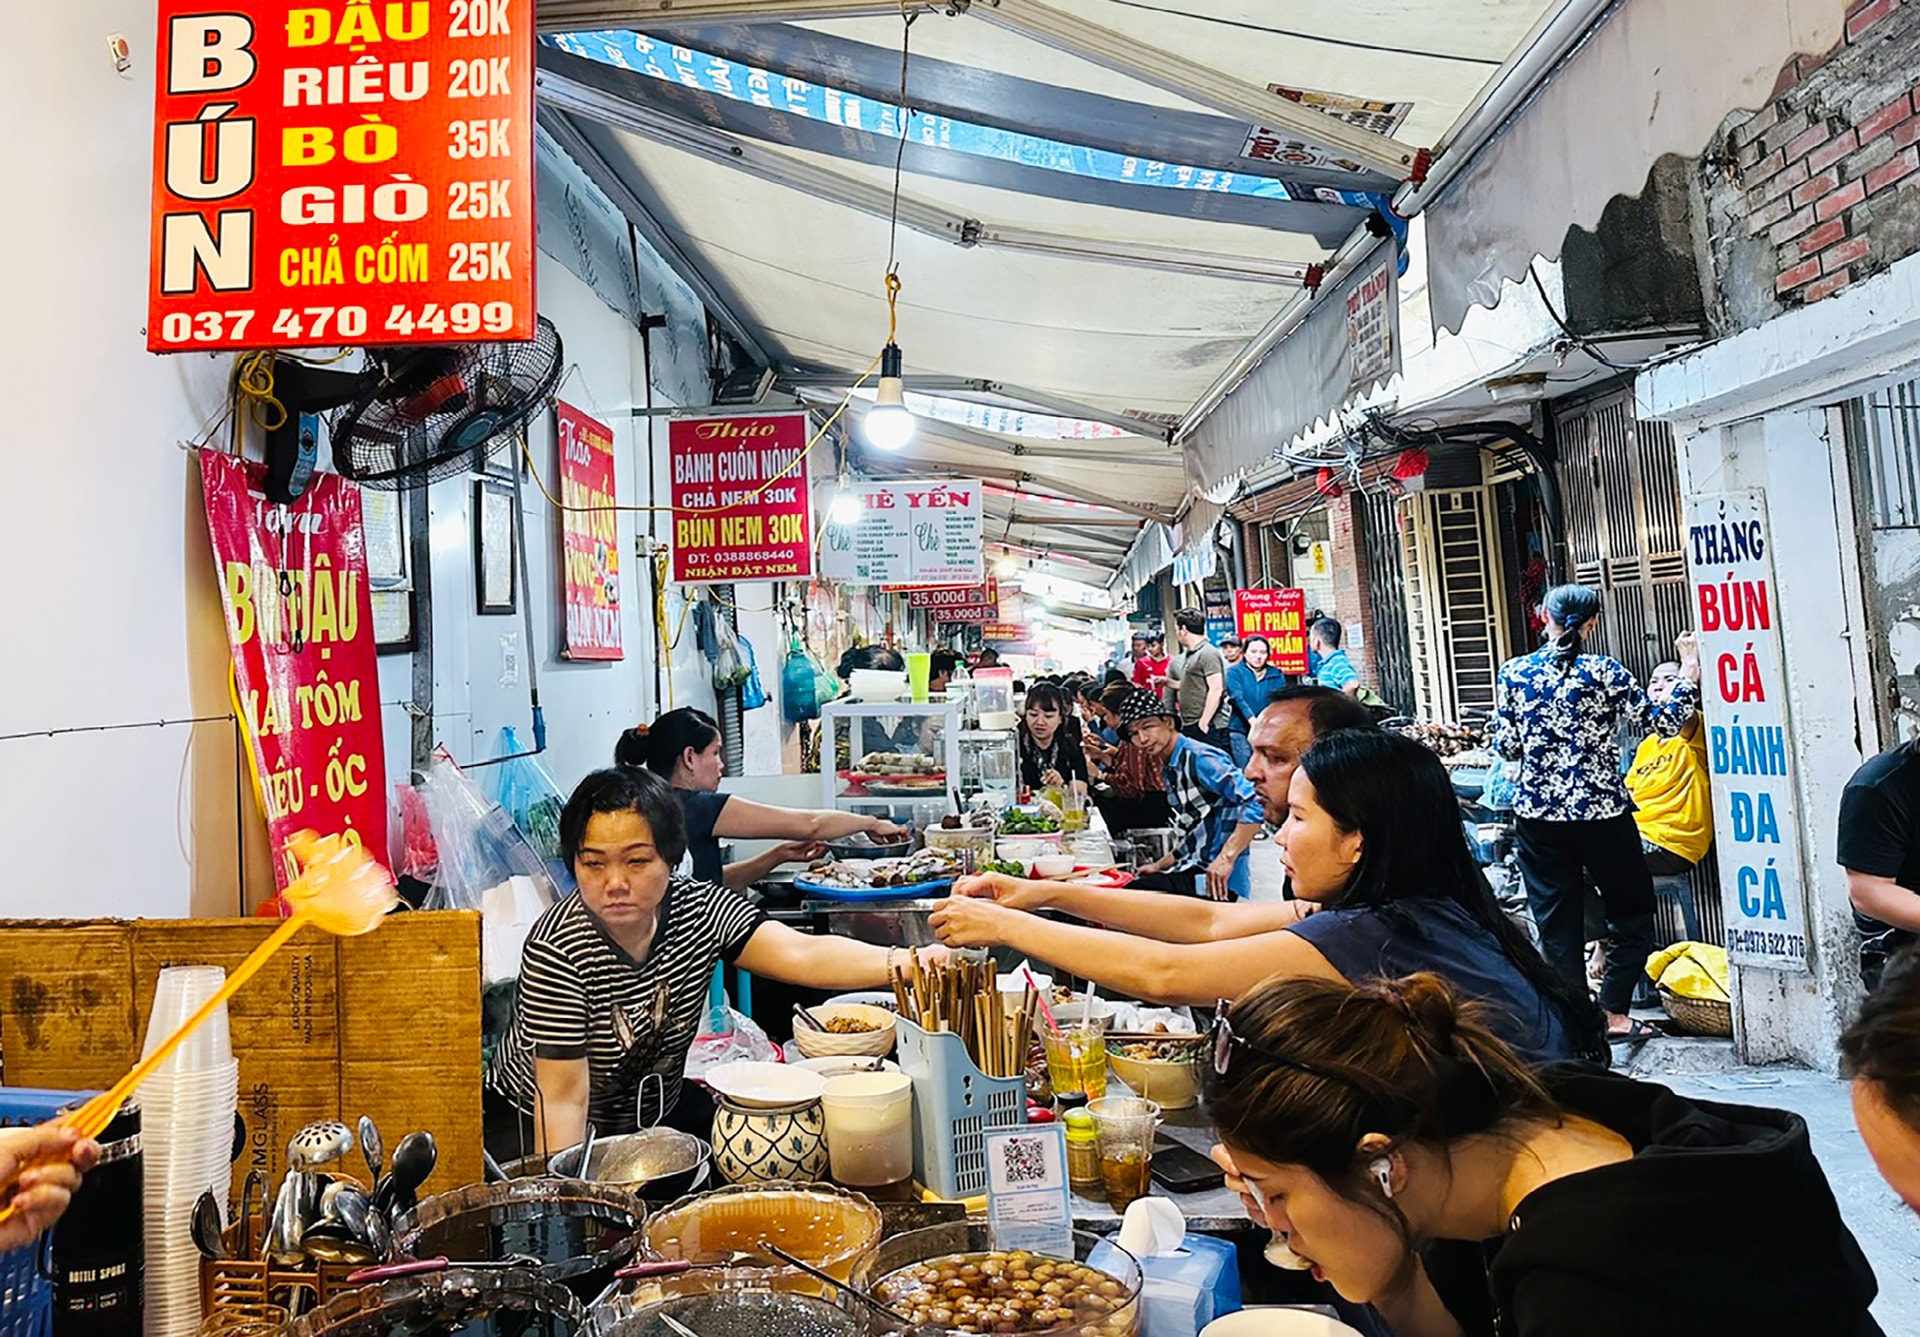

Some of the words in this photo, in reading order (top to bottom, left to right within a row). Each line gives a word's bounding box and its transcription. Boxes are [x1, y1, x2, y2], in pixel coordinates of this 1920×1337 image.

[285, 0, 430, 52] ĐẬU
[448, 0, 511, 39] 20K
[283, 56, 429, 107] RIÊU
[447, 58, 511, 98] 20K
[160, 12, 257, 297] BÚN
[281, 114, 398, 167] BÒ
[447, 120, 511, 160] 35K
[280, 174, 428, 226] GIÒ
[447, 180, 512, 221] 25K
[279, 234, 344, 287] CHẢ
[355, 232, 428, 285] CỐM
[447, 242, 512, 282] 25K
[162, 311, 256, 343] 037
[272, 306, 367, 339] 470
[384, 302, 513, 336] 4499
[674, 447, 714, 485] BÁNH
[718, 441, 757, 482] CUỐN
[761, 442, 802, 479] NÓNG
[682, 486, 719, 509] CHẢ
[721, 490, 760, 506] NEM
[764, 488, 797, 505] 30K
[904, 485, 971, 509] YẾN
[677, 514, 716, 549] BÚN
[721, 516, 764, 547] NEM
[768, 514, 804, 545] 30K
[684, 565, 728, 578] NHẬN
[731, 563, 763, 577] ĐẶT
[765, 563, 798, 575] NEM
[687, 553, 711, 565] ĐT:
[1698, 571, 1771, 632] BÚN
[1717, 642, 1766, 703] CÁ
[296, 670, 362, 730] TÔM
[325, 737, 368, 803] ỐC
[1711, 715, 1787, 776] BÁNH
[1731, 791, 1780, 844] ĐA
[1737, 857, 1787, 921] CÁ
[99, 1262, 127, 1280] SPORT
